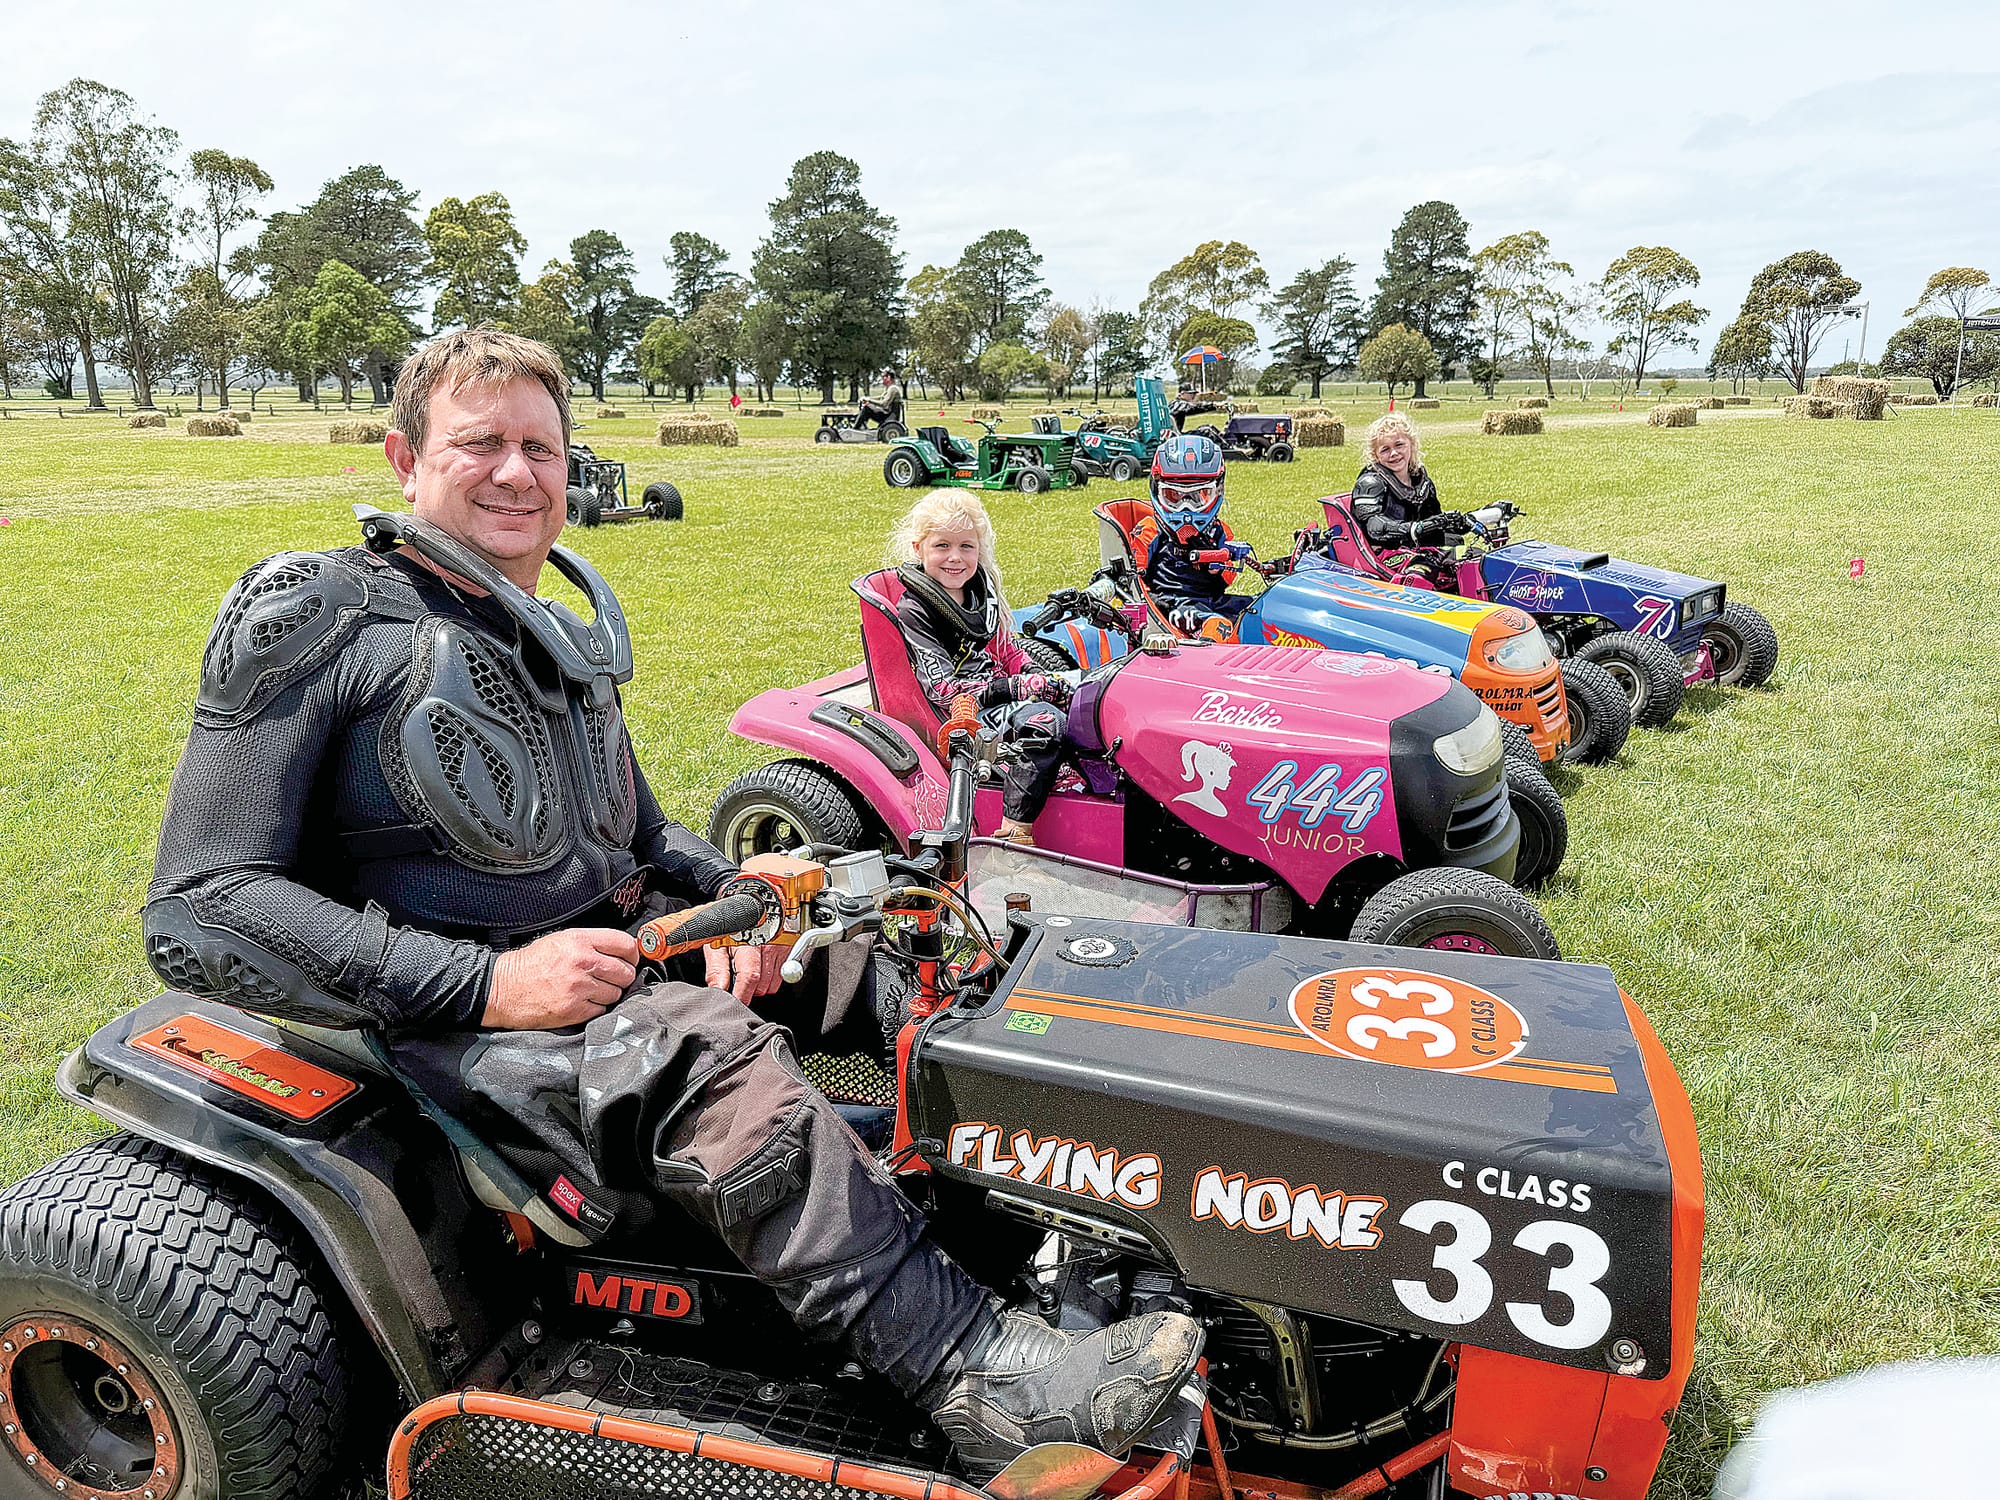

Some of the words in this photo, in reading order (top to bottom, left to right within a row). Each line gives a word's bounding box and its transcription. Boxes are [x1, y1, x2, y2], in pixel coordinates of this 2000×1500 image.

[1140, 392, 1153, 434] DRIFTER
[1509, 585, 1530, 599] GHOST
[1534, 585, 1565, 600] SPIDER
[1192, 691, 1283, 731] Barbie
[1470, 687, 1534, 699] ROLMRA
[1484, 701, 1524, 712] unior
[1246, 760, 1387, 833] 444
[1263, 824, 1366, 855] JUNIOR
[1311, 978, 1337, 1032] AROLMRA
[1346, 976, 1457, 1058] 33
[1470, 1000, 1496, 1042] CLASS
[1471, 1043, 1497, 1056] C
[557, 1182, 580, 1204] spex
[720, 1148, 804, 1227] FOX
[949, 1122, 1163, 1209] FLYING
[1192, 1165, 1388, 1250] NONE
[1442, 1160, 1465, 1189] C
[1476, 1167, 1592, 1213] CLASS
[581, 1203, 609, 1223] Vigour
[574, 1271, 691, 1318] MTD
[1391, 1199, 1613, 1350] 33
